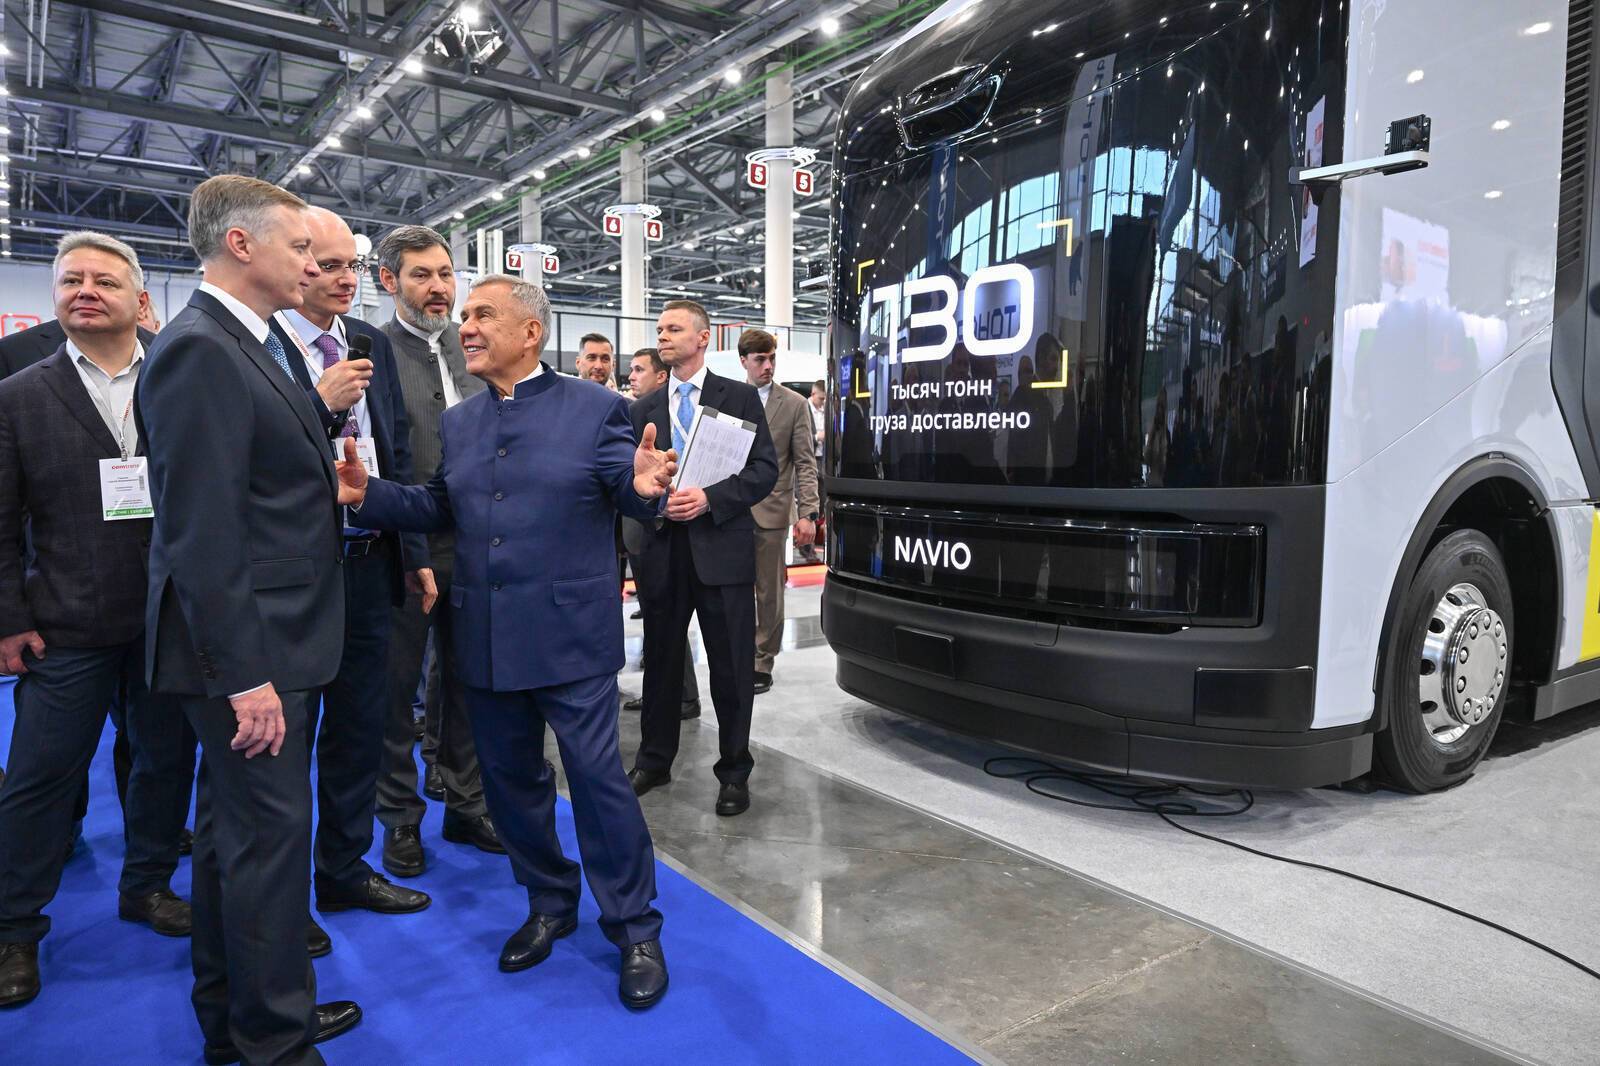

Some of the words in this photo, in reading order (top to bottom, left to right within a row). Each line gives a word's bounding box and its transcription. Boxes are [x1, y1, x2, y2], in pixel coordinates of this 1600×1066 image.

[754, 166, 764, 182] 5
[799, 174, 808, 190] 5
[891, 382, 940, 400] тысяч
[945, 379, 993, 397] тонн
[869, 414, 907, 434] груза
[911, 411, 1031, 433] доставлено
[894, 535, 972, 570] NAVIO
